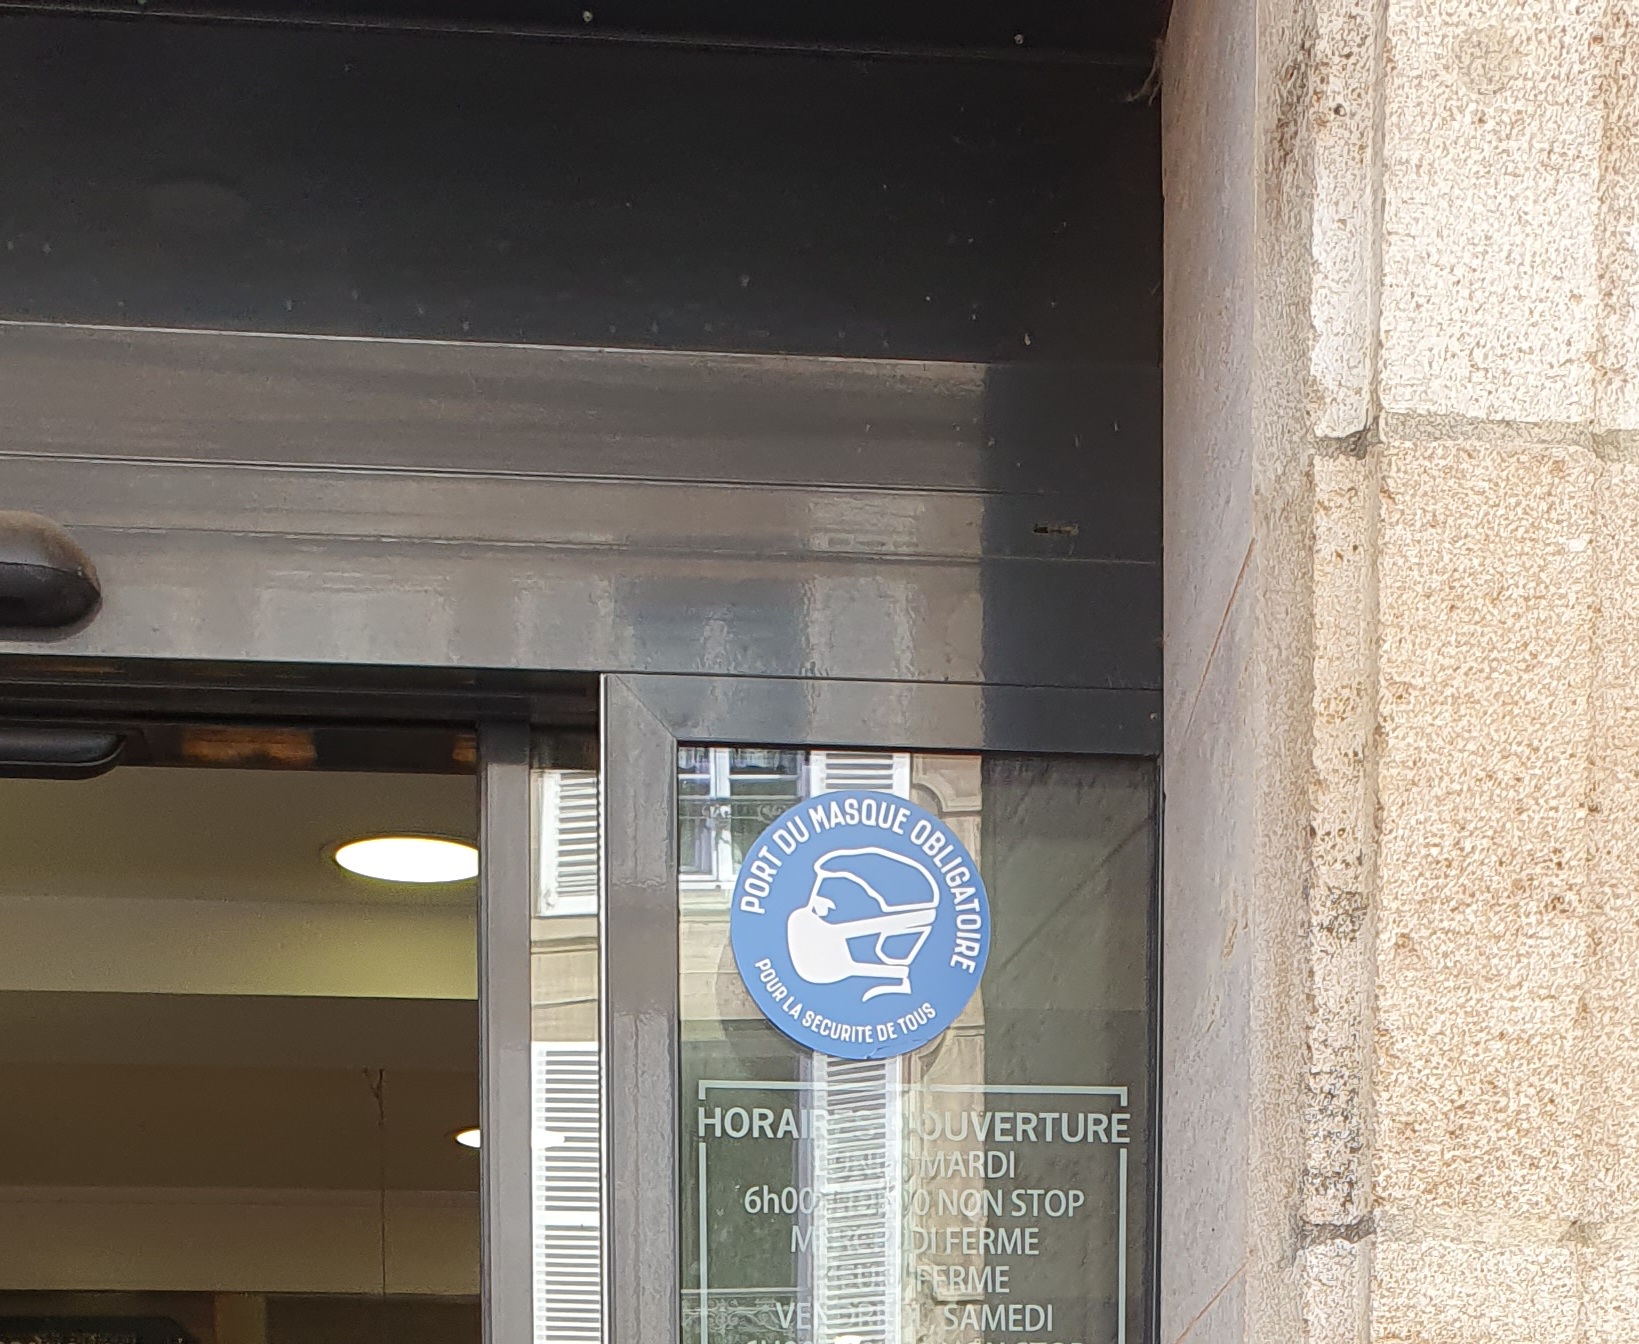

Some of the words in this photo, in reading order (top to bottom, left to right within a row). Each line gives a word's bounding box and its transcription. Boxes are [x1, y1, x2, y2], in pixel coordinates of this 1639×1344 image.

[740, 845, 783, 915] PORT
[772, 816, 810, 855] DU
[808, 798, 912, 836] MASQUE
[910, 819, 982, 974] OBLIGATOIRE
[754, 957, 788, 1003] POUR
[781, 996, 804, 1020] LA
[876, 1023, 898, 1042] DE
[896, 1002, 937, 1035] TOUS
[919, 1150, 1015, 1179] MARDI
[938, 1188, 1003, 1217] NON
[1011, 1189, 1085, 1218] STOP
[946, 1227, 1040, 1256] FERME
[916, 1265, 1010, 1294] FERME
[943, 1303, 1053, 1332] SAMEDI
